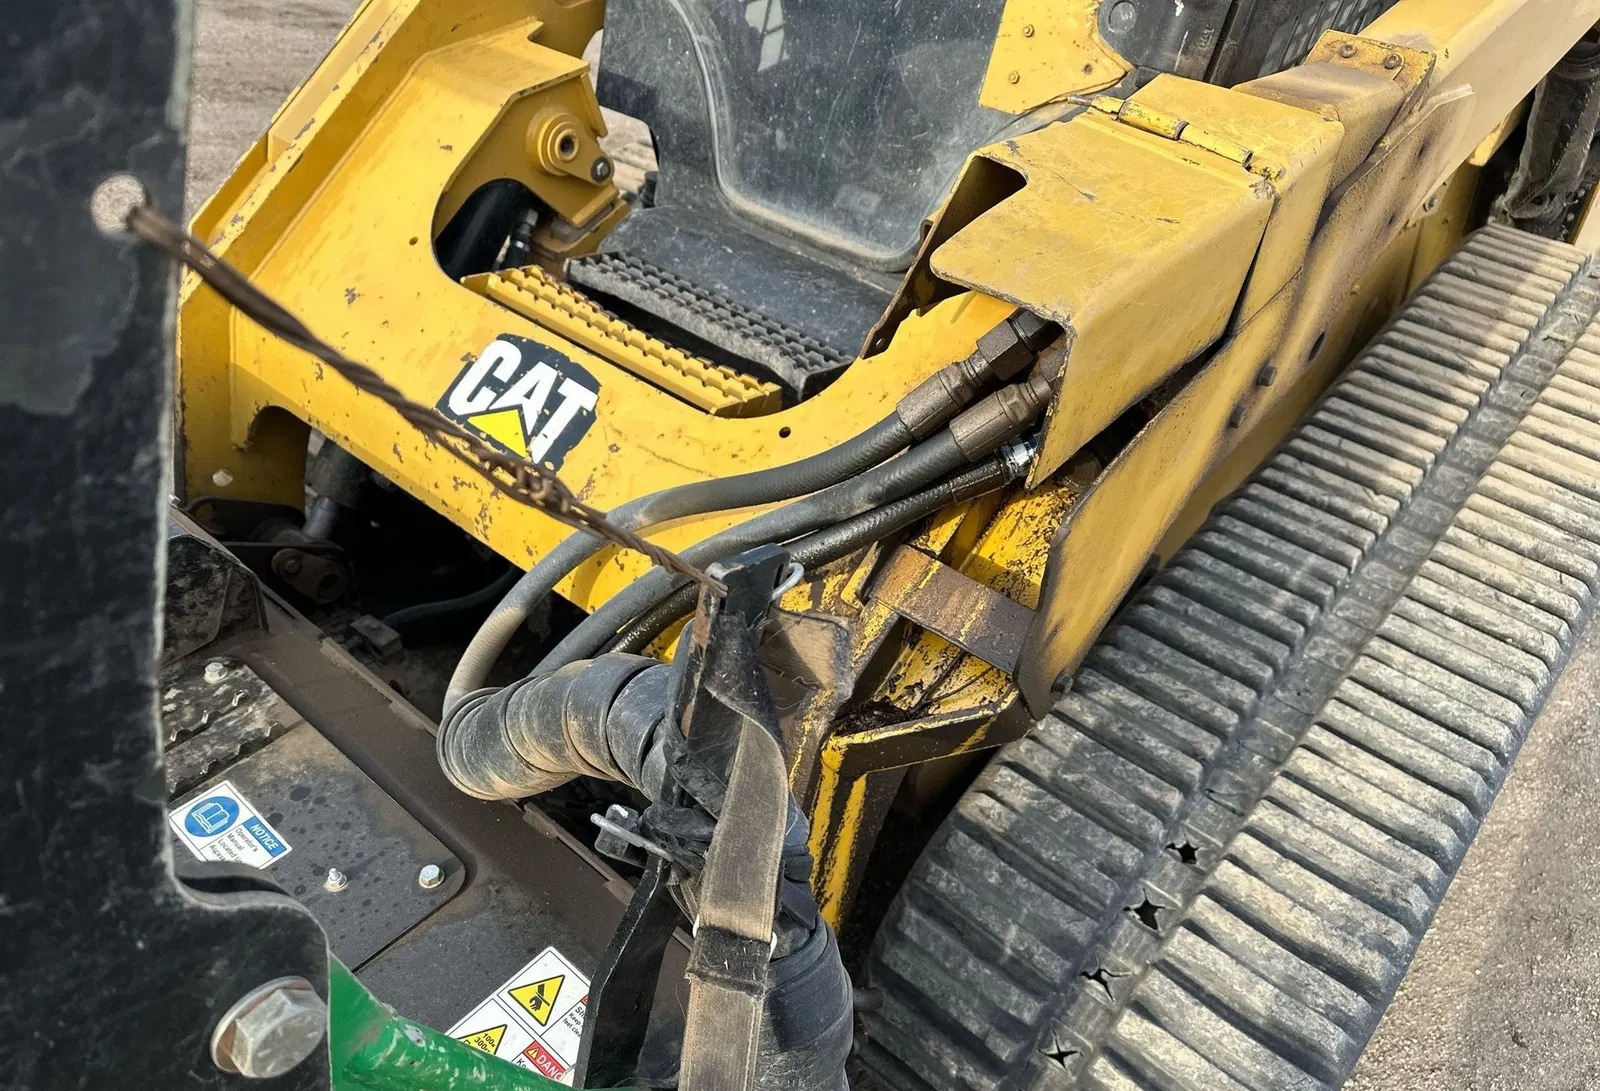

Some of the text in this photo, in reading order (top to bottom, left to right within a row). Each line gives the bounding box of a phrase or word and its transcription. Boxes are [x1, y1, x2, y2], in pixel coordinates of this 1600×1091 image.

[448, 340, 599, 464] CAT
[218, 838, 238, 858] Located
[226, 833, 245, 851] Manual
[235, 827, 258, 852] Operator's
[250, 824, 278, 850] NOTICE
[568, 1012, 581, 1026] Keep
[575, 1006, 586, 1018] Sh
[536, 1055, 563, 1082] DANG
